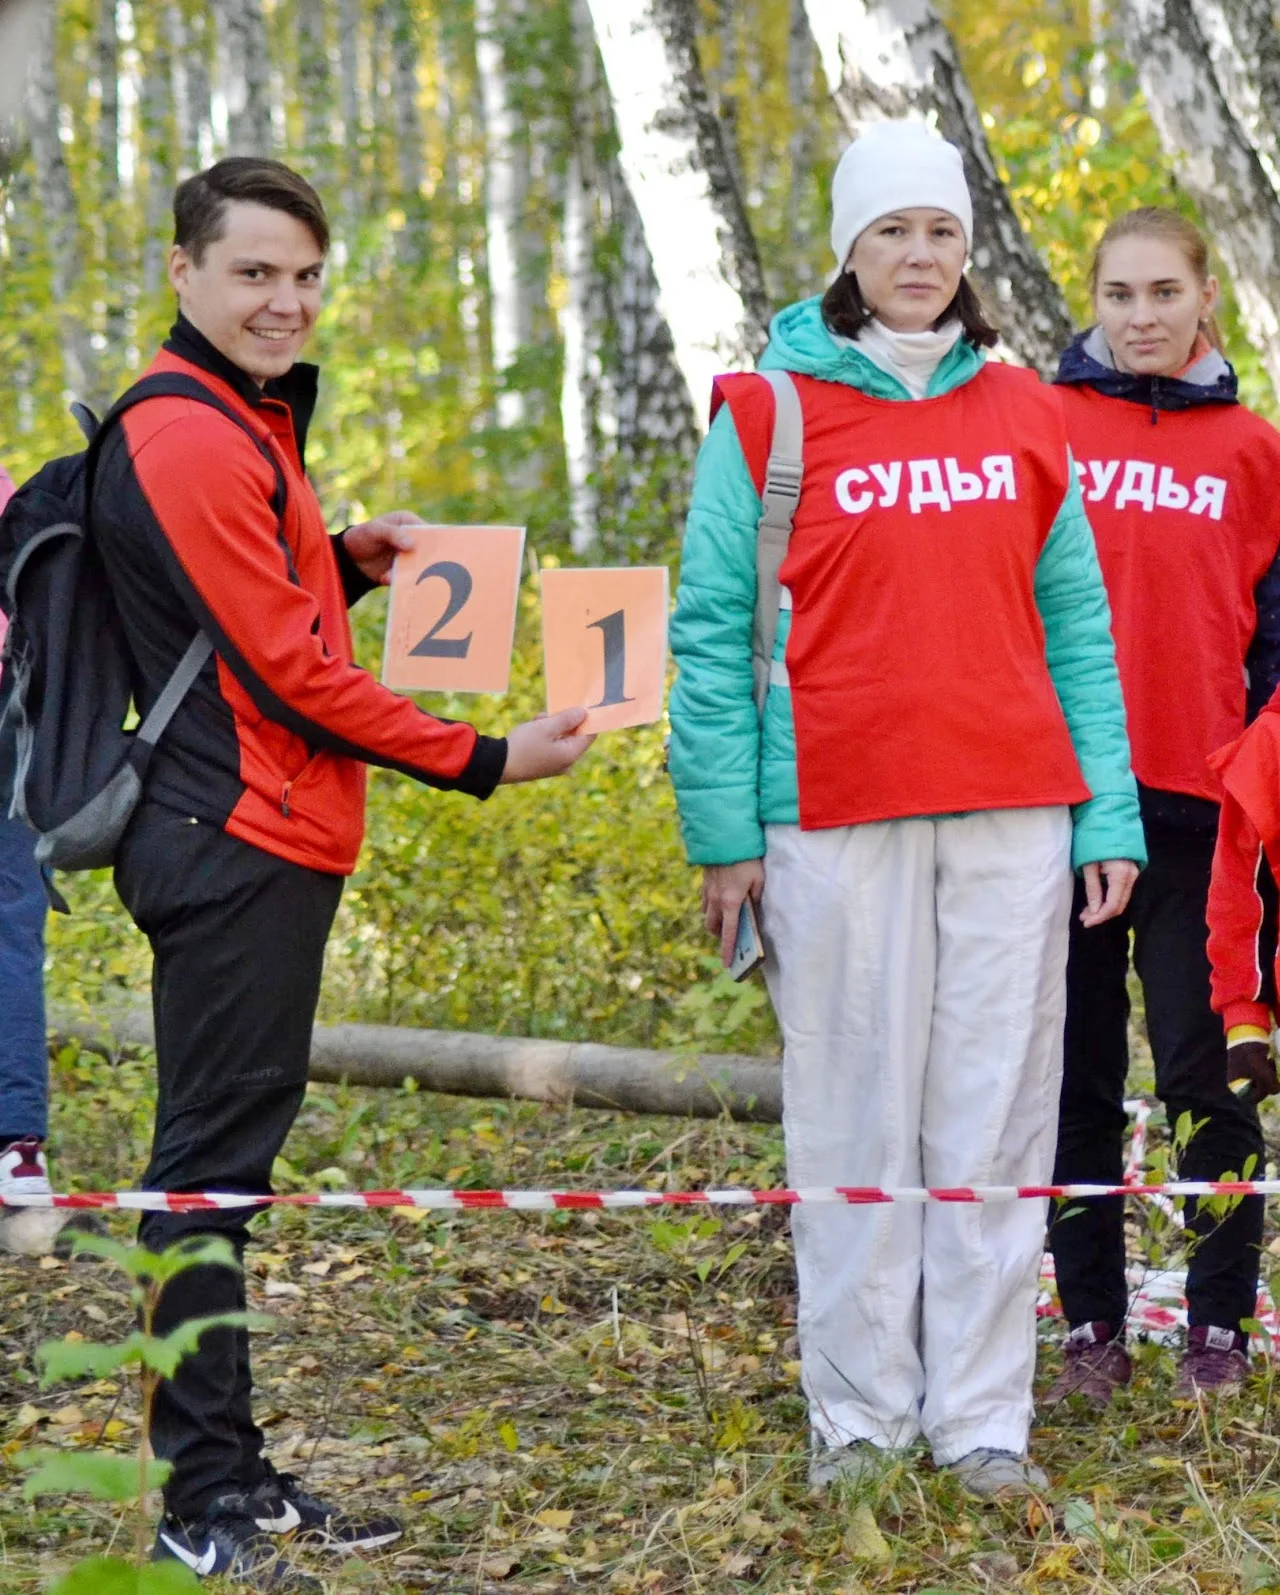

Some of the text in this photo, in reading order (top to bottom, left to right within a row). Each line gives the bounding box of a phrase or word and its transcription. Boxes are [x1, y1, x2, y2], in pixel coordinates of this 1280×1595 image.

[835, 455, 1017, 514] СУДЬЯ
[407, 561, 473, 659] 2
[585, 608, 636, 709] 1
